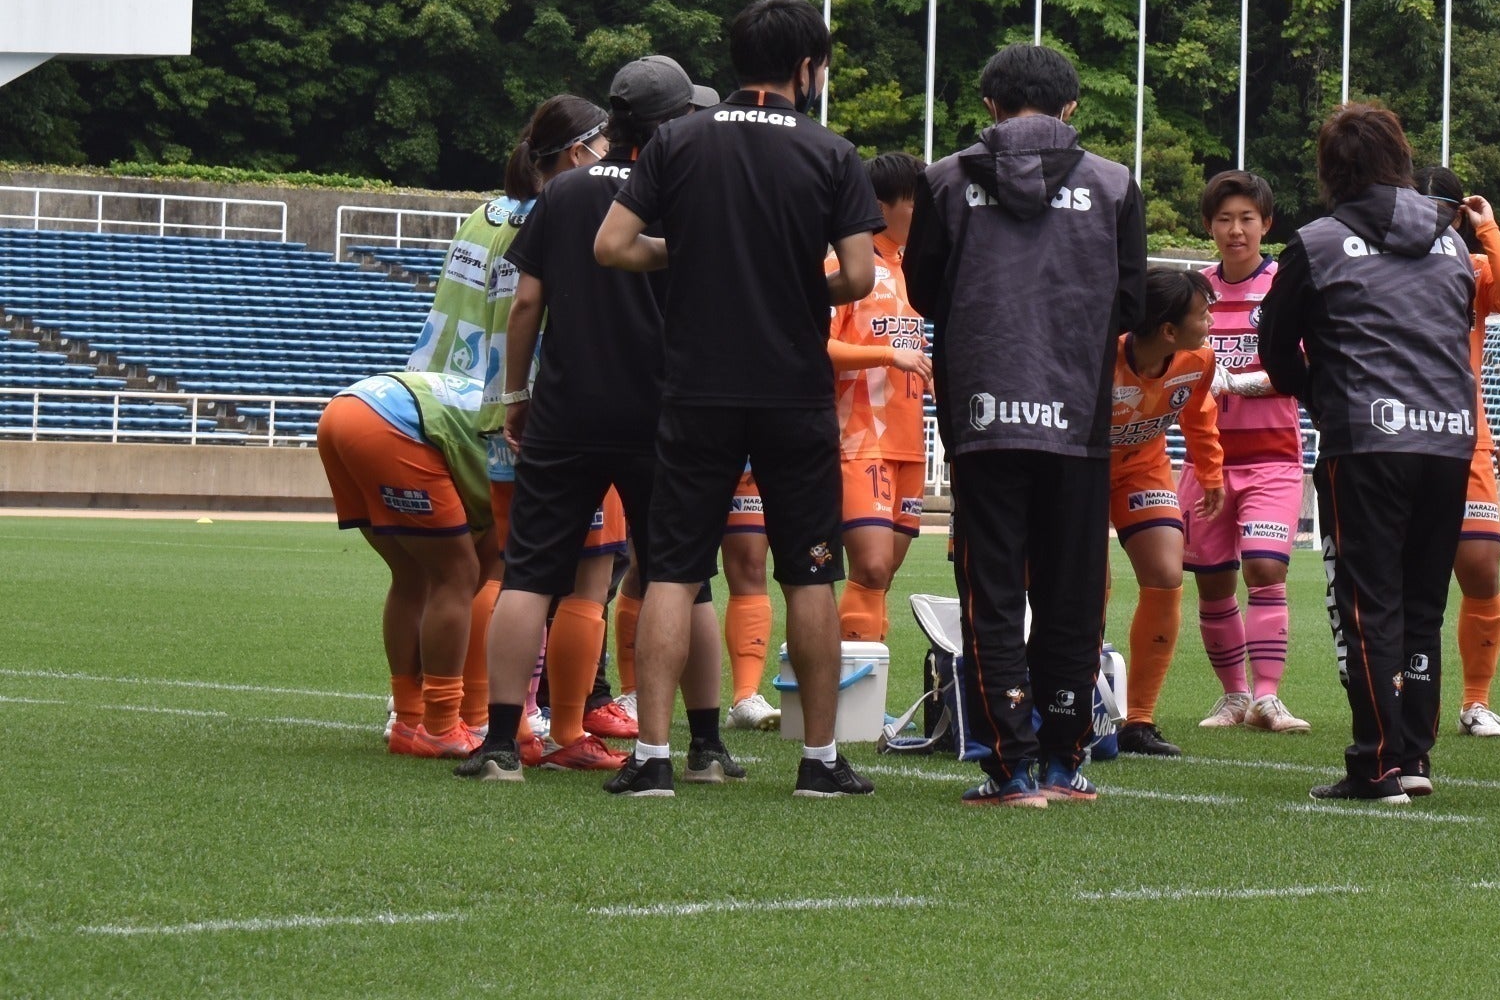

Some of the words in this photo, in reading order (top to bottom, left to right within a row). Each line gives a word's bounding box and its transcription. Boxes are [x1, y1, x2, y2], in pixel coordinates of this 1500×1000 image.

[865, 464, 891, 500] 15
[1253, 523, 1289, 533] NARAZAKI
[1252, 530, 1288, 541] INDUSTRY
